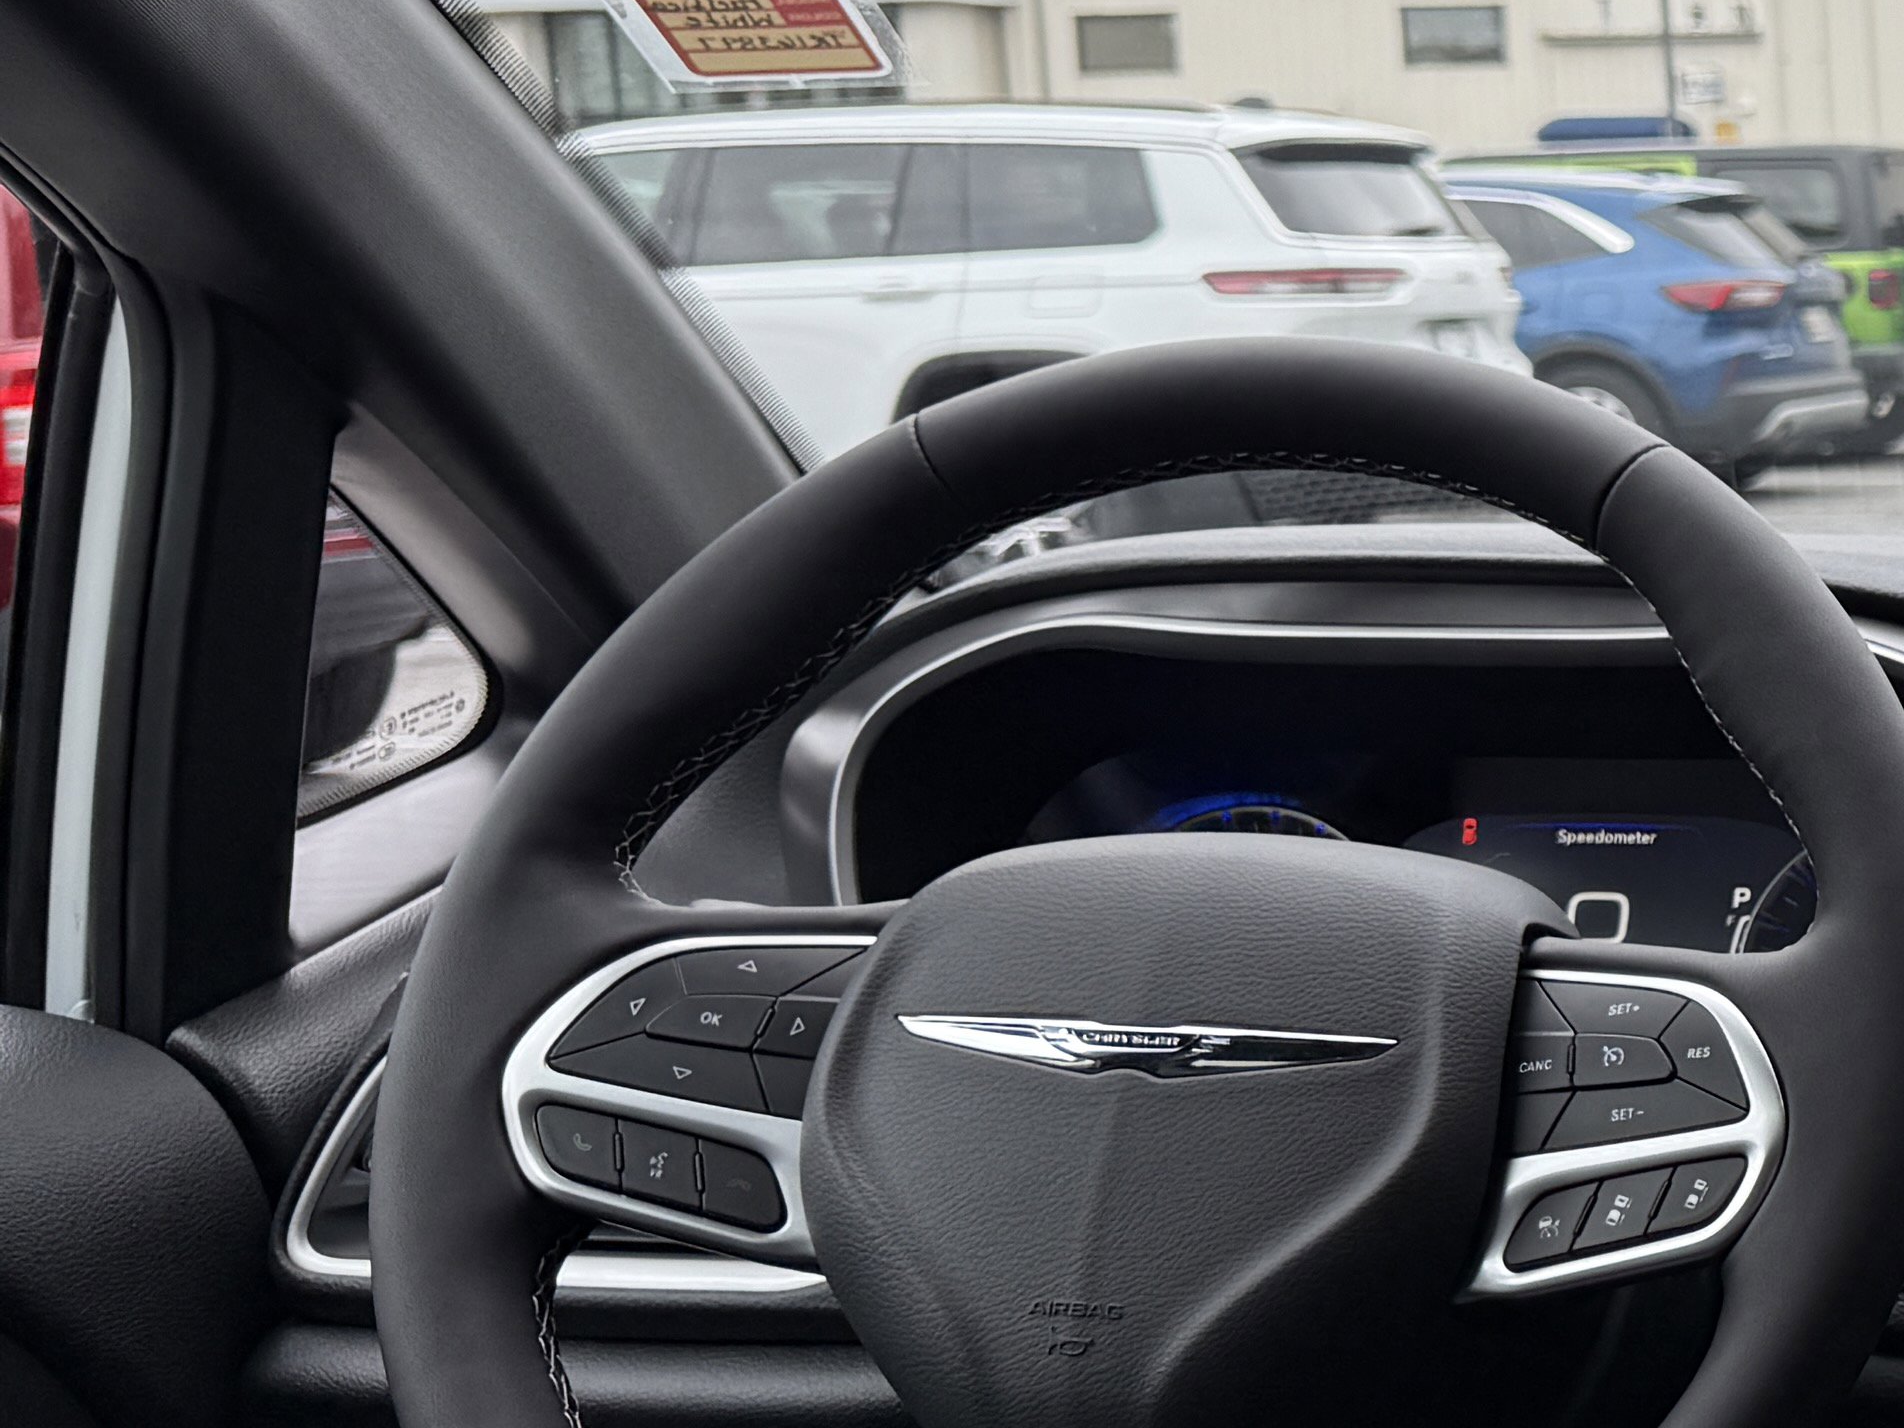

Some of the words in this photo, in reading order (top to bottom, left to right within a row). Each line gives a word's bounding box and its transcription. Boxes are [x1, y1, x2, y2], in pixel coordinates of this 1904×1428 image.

[1556, 829, 1657, 847] Speedometer
[1731, 887, 1752, 909] P
[700, 1012, 723, 1026] OK
[1082, 1032, 1181, 1048] CHRYSLER
[1687, 1047, 1711, 1059] RES
[1519, 1059, 1553, 1073] CANC
[1027, 1301, 1125, 1320] AIRBAG
